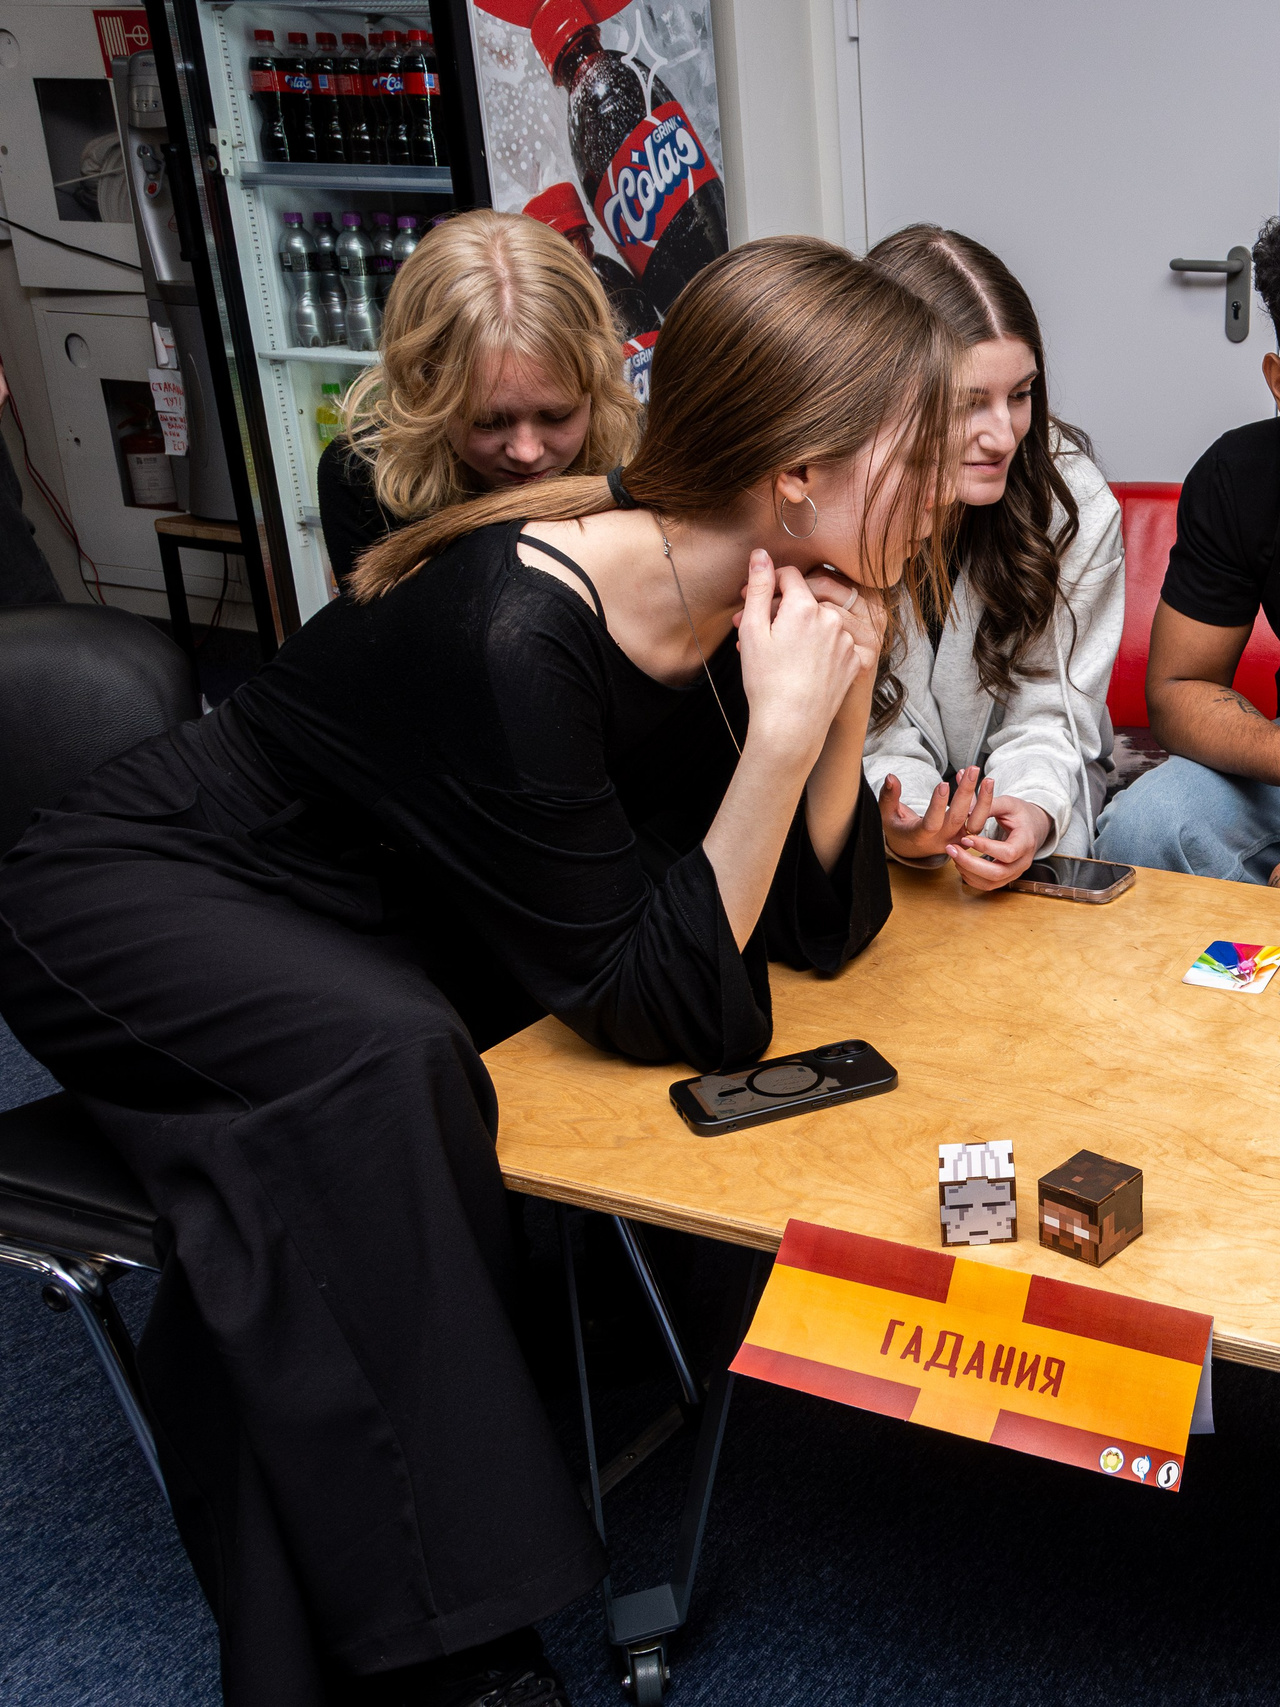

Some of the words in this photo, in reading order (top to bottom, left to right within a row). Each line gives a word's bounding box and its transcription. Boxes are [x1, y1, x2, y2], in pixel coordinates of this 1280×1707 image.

[652, 117, 679, 143] GRINK
[632, 346, 655, 368] GRIN
[879, 1318, 1066, 1397] ГАДАНИЯ
